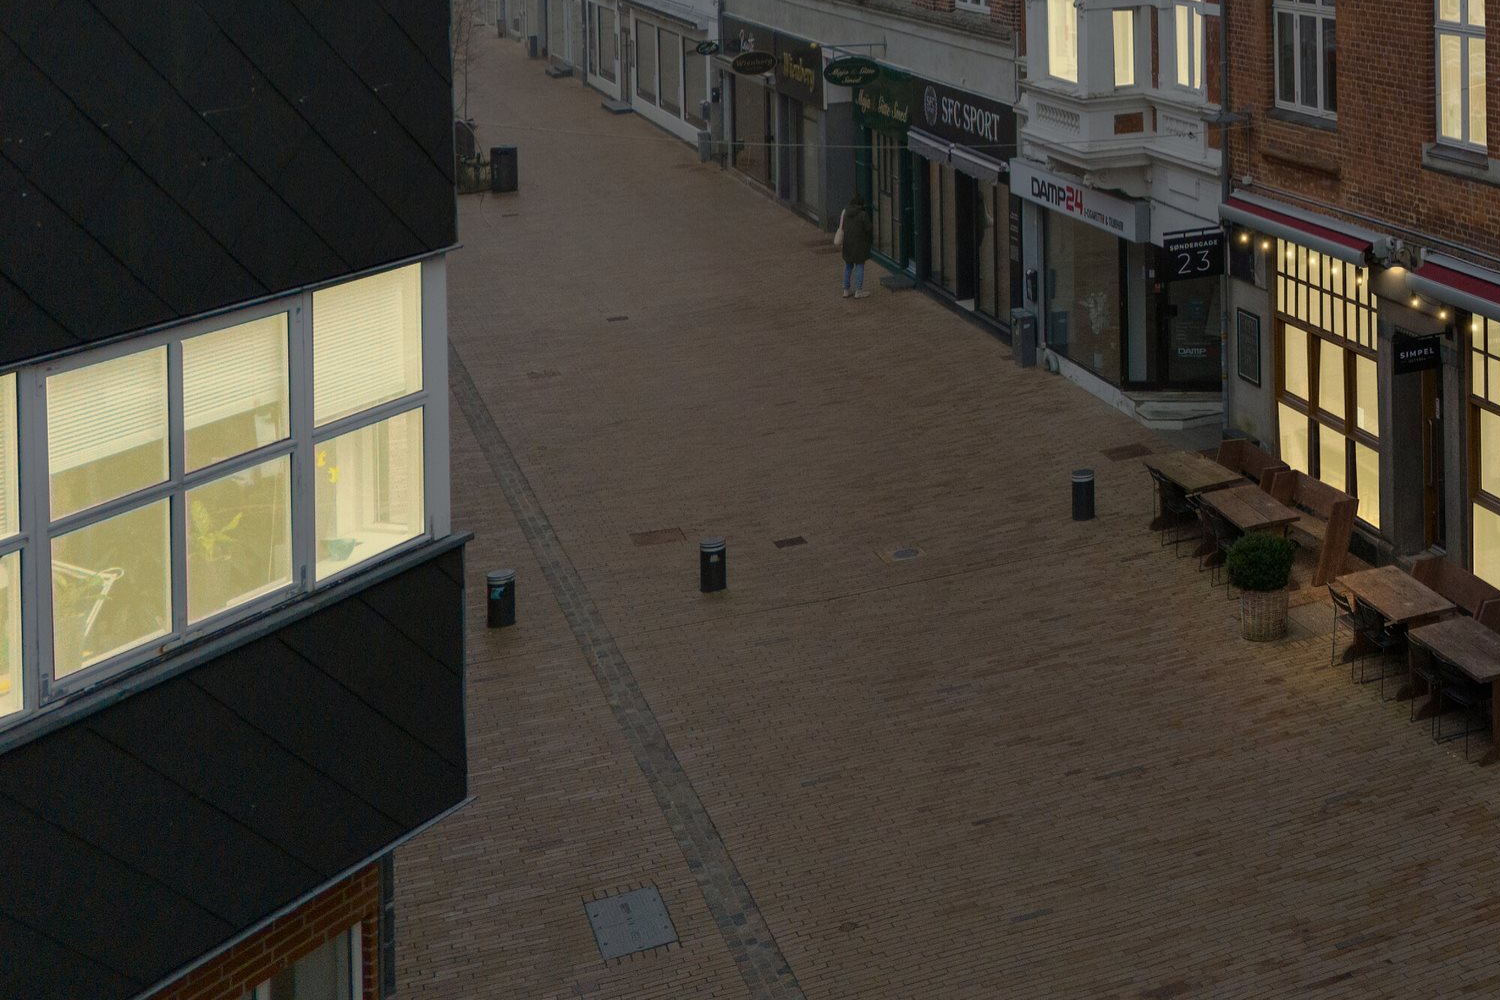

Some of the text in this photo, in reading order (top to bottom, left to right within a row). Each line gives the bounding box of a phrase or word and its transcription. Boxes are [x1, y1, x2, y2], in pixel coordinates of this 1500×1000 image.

[941, 96, 1000, 142] SFC SPORT
[1031, 175, 1083, 215] DAMP24
[1169, 240, 1218, 252] SØNDERGADE
[1177, 250, 1211, 275] 23
[1400, 347, 1434, 360] SIMPEL
